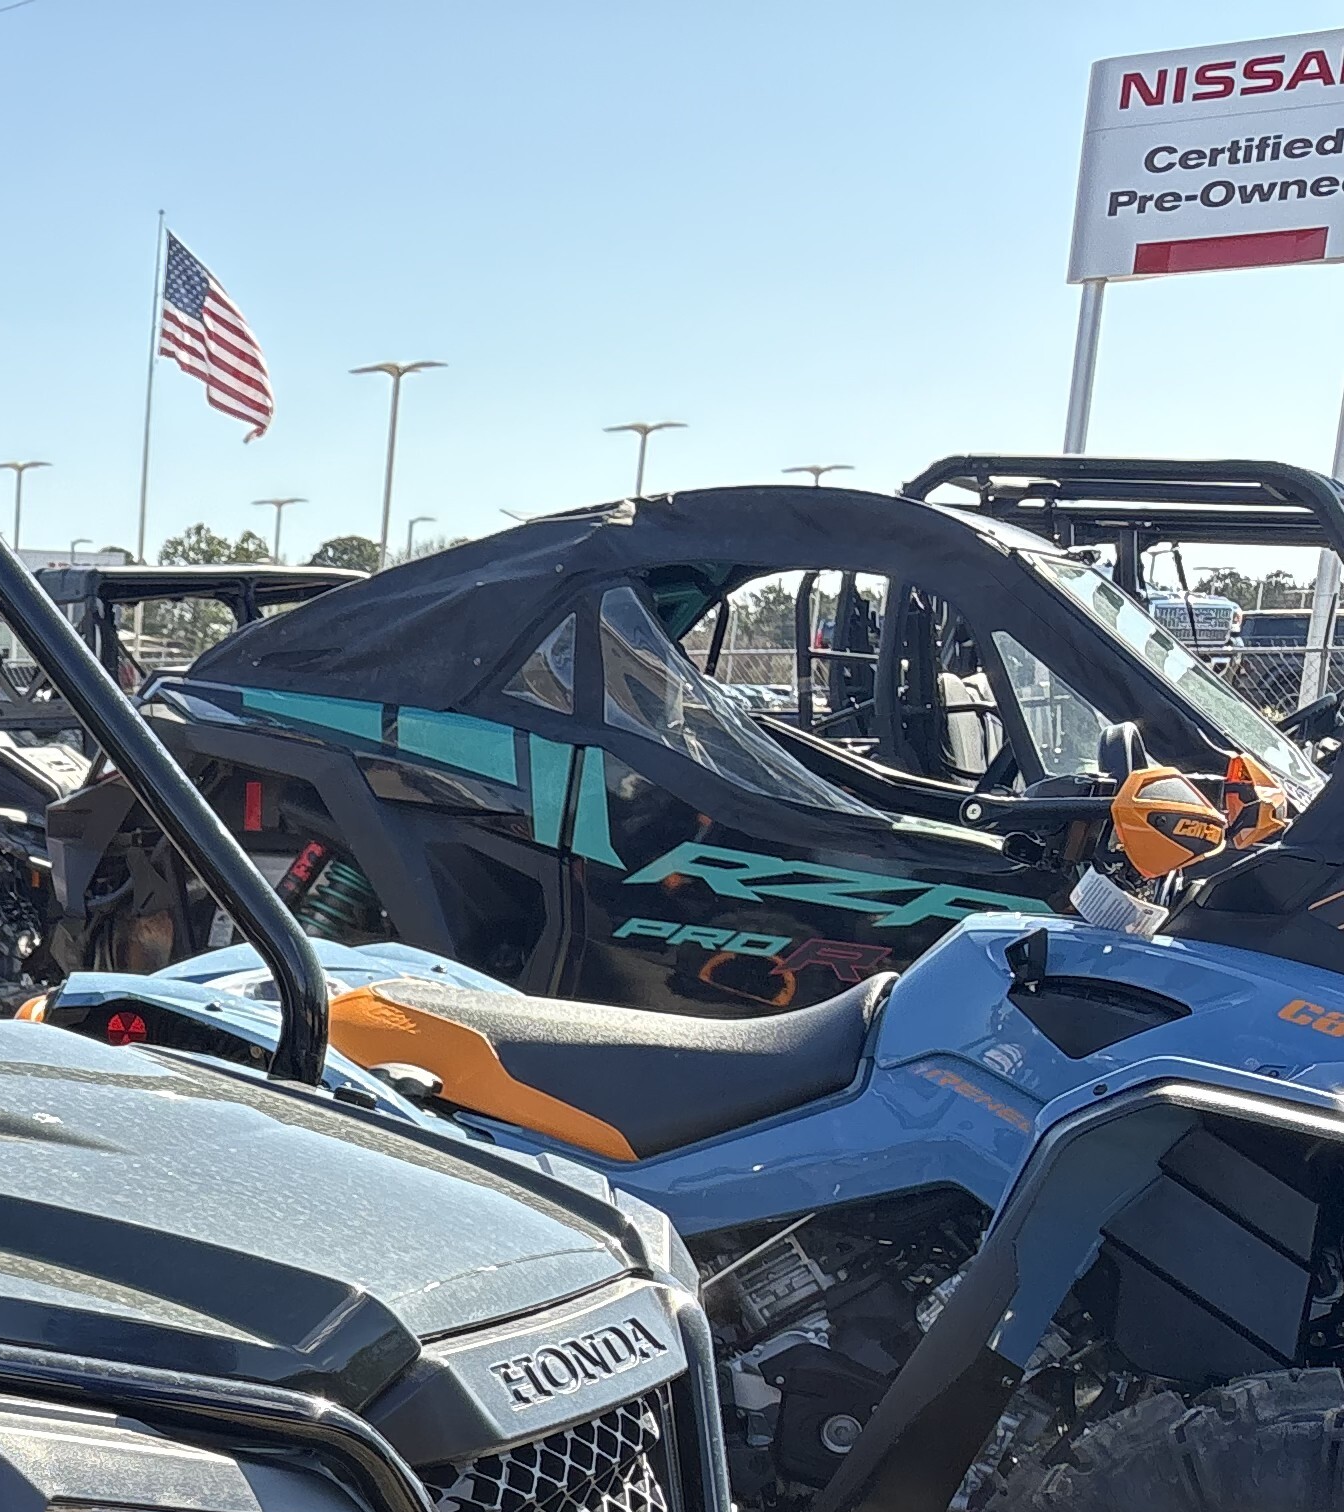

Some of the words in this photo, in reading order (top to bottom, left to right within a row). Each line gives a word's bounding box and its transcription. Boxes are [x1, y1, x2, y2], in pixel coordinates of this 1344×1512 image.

[1119, 50, 1344, 110] NISSA
[1144, 128, 1344, 174] Certified
[1108, 176, 1344, 217] Pre-Owne
[612, 917, 793, 957] PRO
[488, 1317, 668, 1410] HONDA
